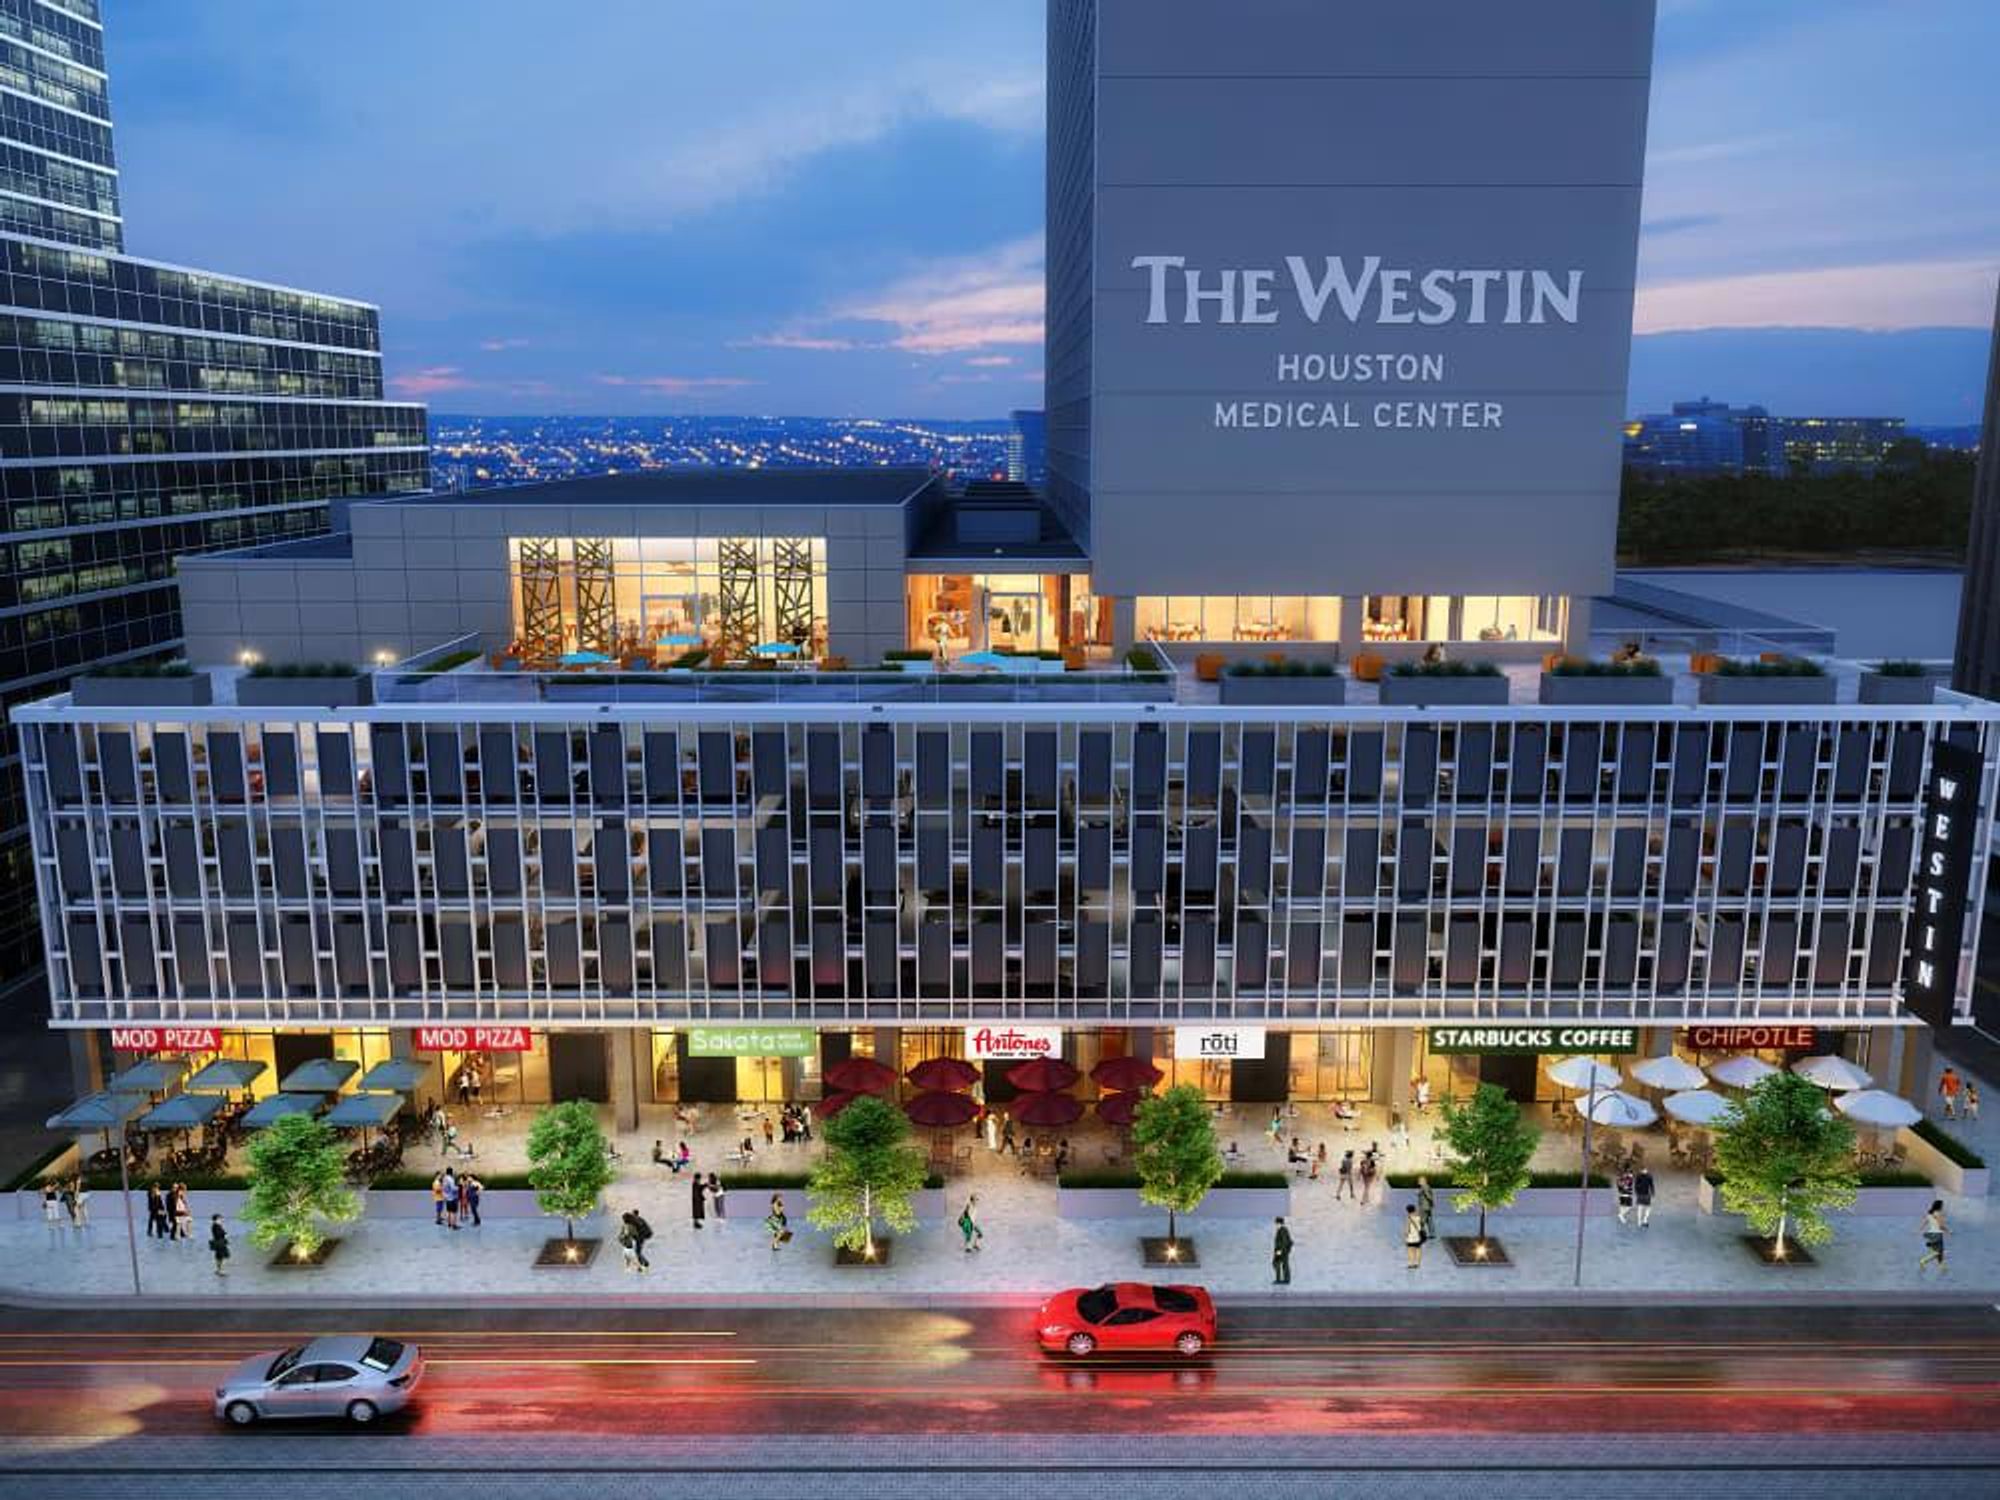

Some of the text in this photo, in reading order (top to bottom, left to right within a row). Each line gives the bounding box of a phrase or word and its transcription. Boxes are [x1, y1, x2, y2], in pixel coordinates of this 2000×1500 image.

[1131, 256, 1584, 324] THE WESTIN
[1277, 354, 1444, 382] HOUSTON
[1214, 402, 1504, 428] MEDICAL CENTER
[1917, 777, 1957, 988] WESTIN
[112, 1029, 215, 1048] MOD PIZZA
[421, 1029, 526, 1048] MOD PIZZA
[692, 1029, 775, 1051] Salata
[1434, 1029, 1633, 1048] STARBUCKS COFFEE
[1695, 1027, 1812, 1047] CHIPOTLE
